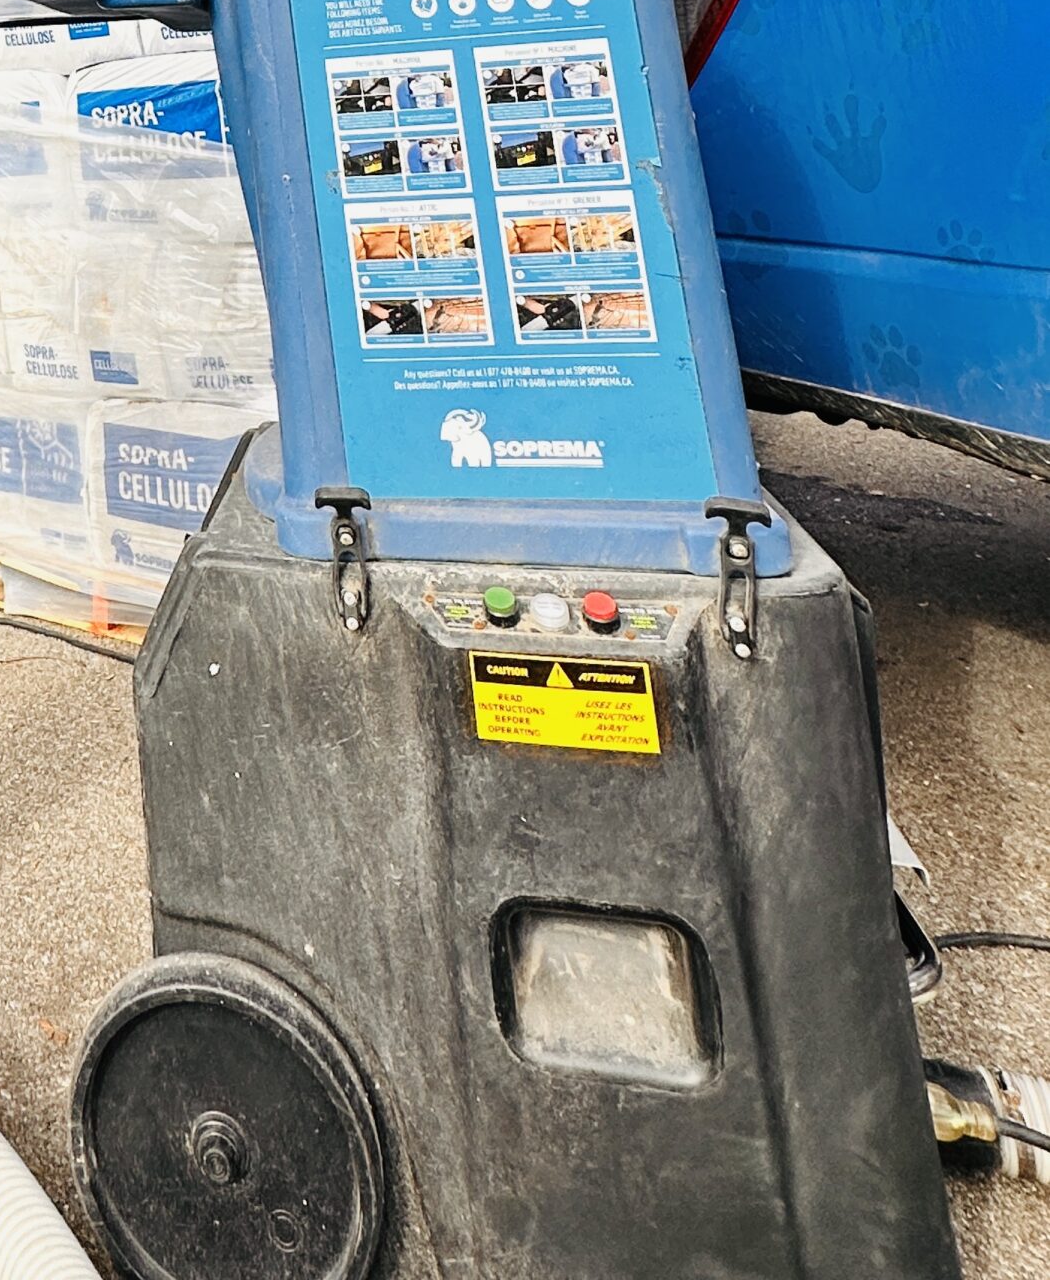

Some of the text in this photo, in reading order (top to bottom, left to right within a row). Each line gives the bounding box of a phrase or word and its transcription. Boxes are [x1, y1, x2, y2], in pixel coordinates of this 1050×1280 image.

[5, 30, 55, 46] CELLULOSE
[91, 100, 164, 128] SOPRA-
[26, 362, 80, 380] CELLULOSE
[493, 440, 602, 458] SOPREMA
[118, 471, 219, 513] CELLULO
[135, 552, 176, 569] SOPRE
[486, 664, 529, 677] CAUTION
[497, 693, 523, 702] READ
[478, 702, 546, 716] INSTRUCTIONS
[614, 702, 632, 711] LES
[494, 714, 531, 725] BEFORE
[575, 711, 646, 723] INSTRUCTIONS
[488, 725, 542, 737] OPERATING
[596, 724, 629, 732] AVANT
